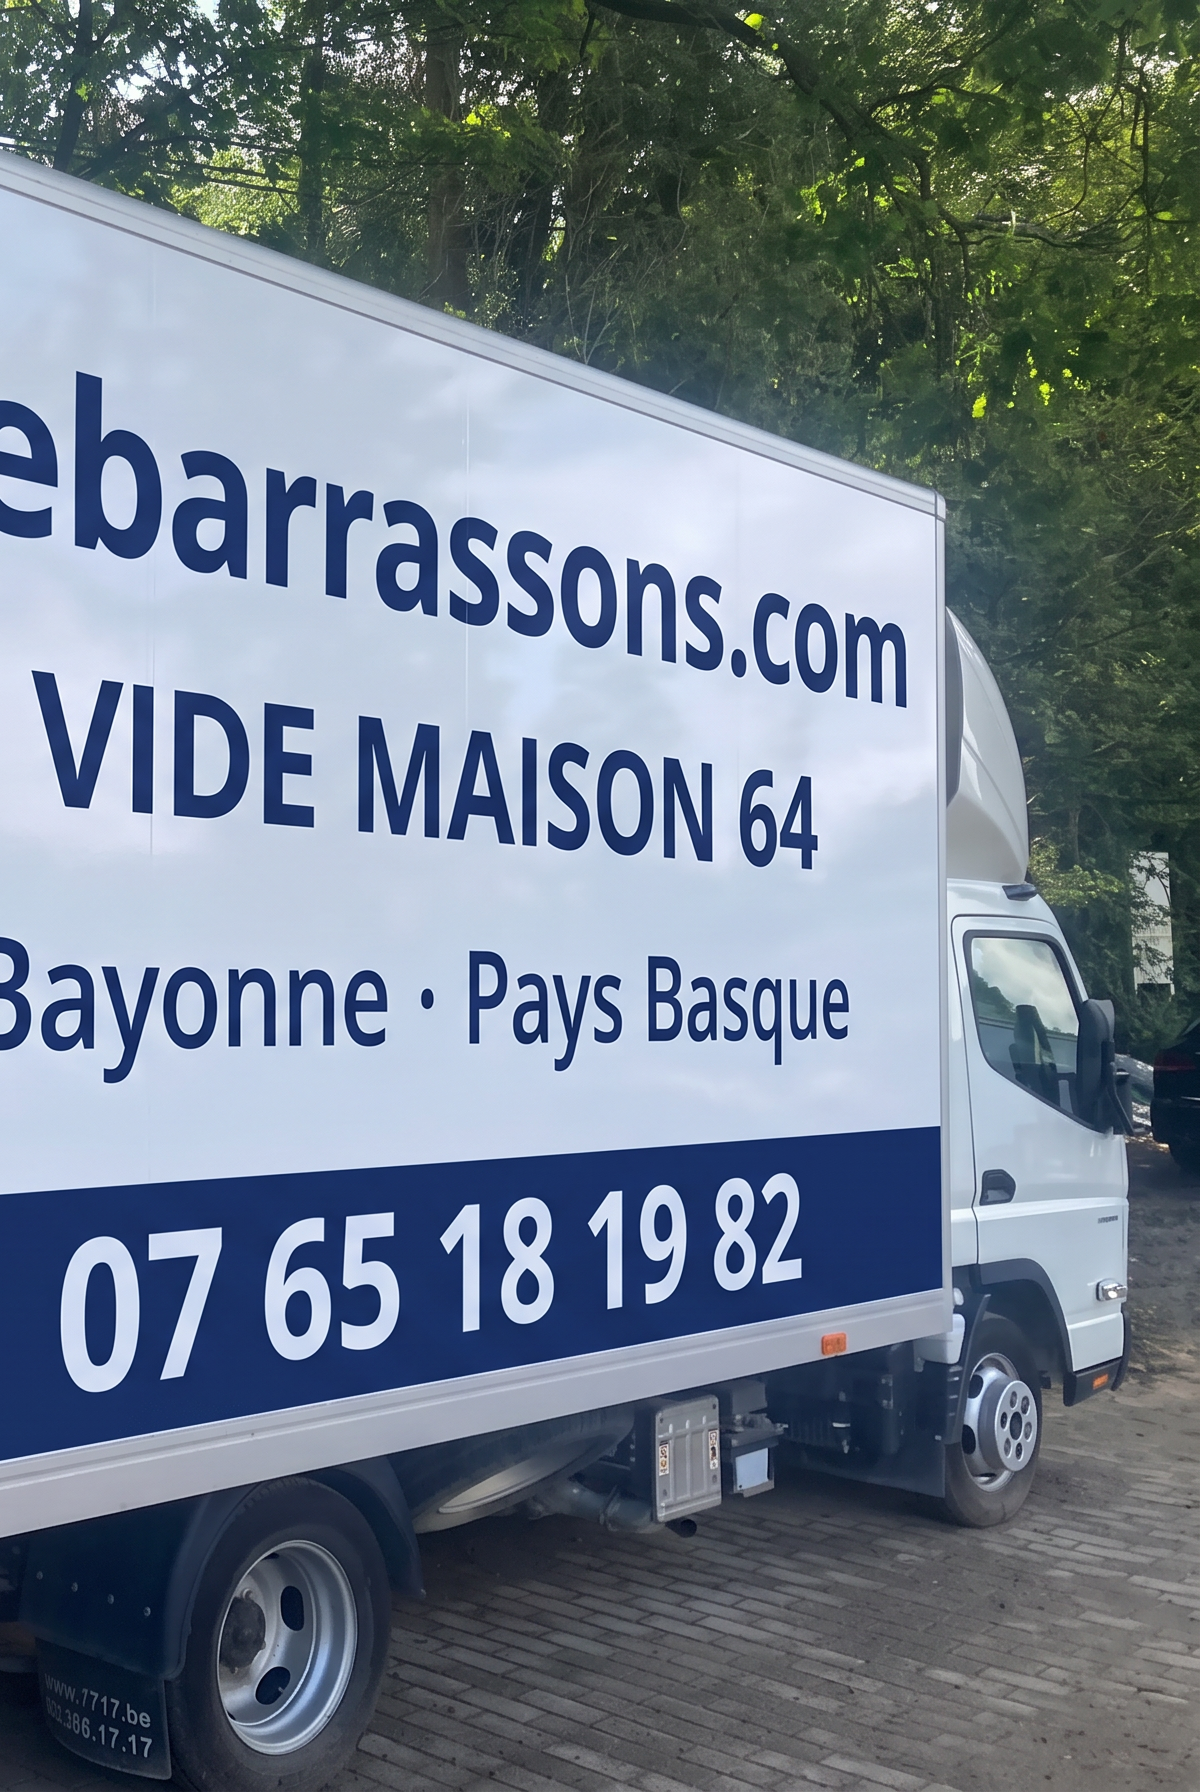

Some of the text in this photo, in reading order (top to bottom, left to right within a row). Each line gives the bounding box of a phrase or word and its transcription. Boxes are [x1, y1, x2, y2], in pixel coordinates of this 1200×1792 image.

[31, 669, 819, 870] VIDE MAISON 64
[468, 950, 623, 1072] Pays
[647, 955, 850, 1066] Basque
[60, 1172, 802, 1393] 07 65 18 19 82
